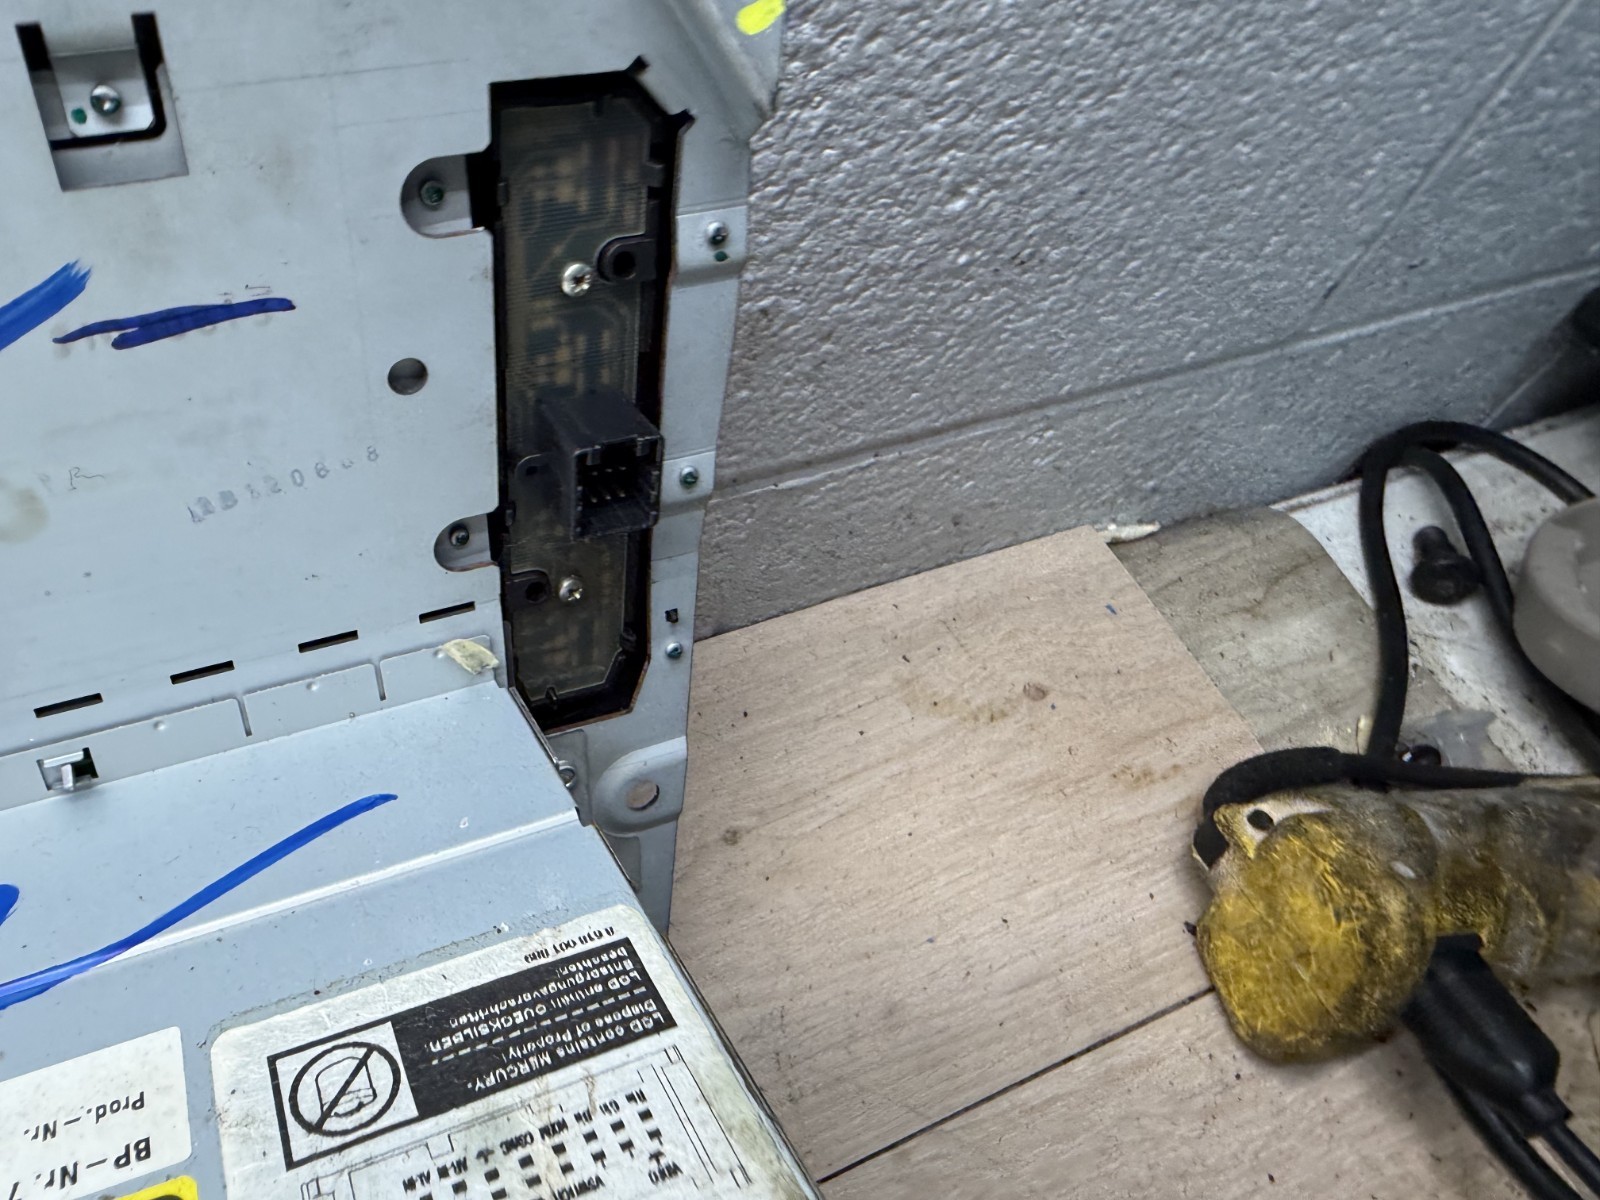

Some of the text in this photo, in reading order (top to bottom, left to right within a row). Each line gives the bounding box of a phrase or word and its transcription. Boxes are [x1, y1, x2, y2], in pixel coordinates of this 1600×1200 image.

[608, 970, 642, 990] LCD
[596, 998, 657, 1028] Dispose
[630, 1011, 665, 1032] LCD
[576, 1021, 591, 1038] of
[556, 1024, 625, 1058] contains
